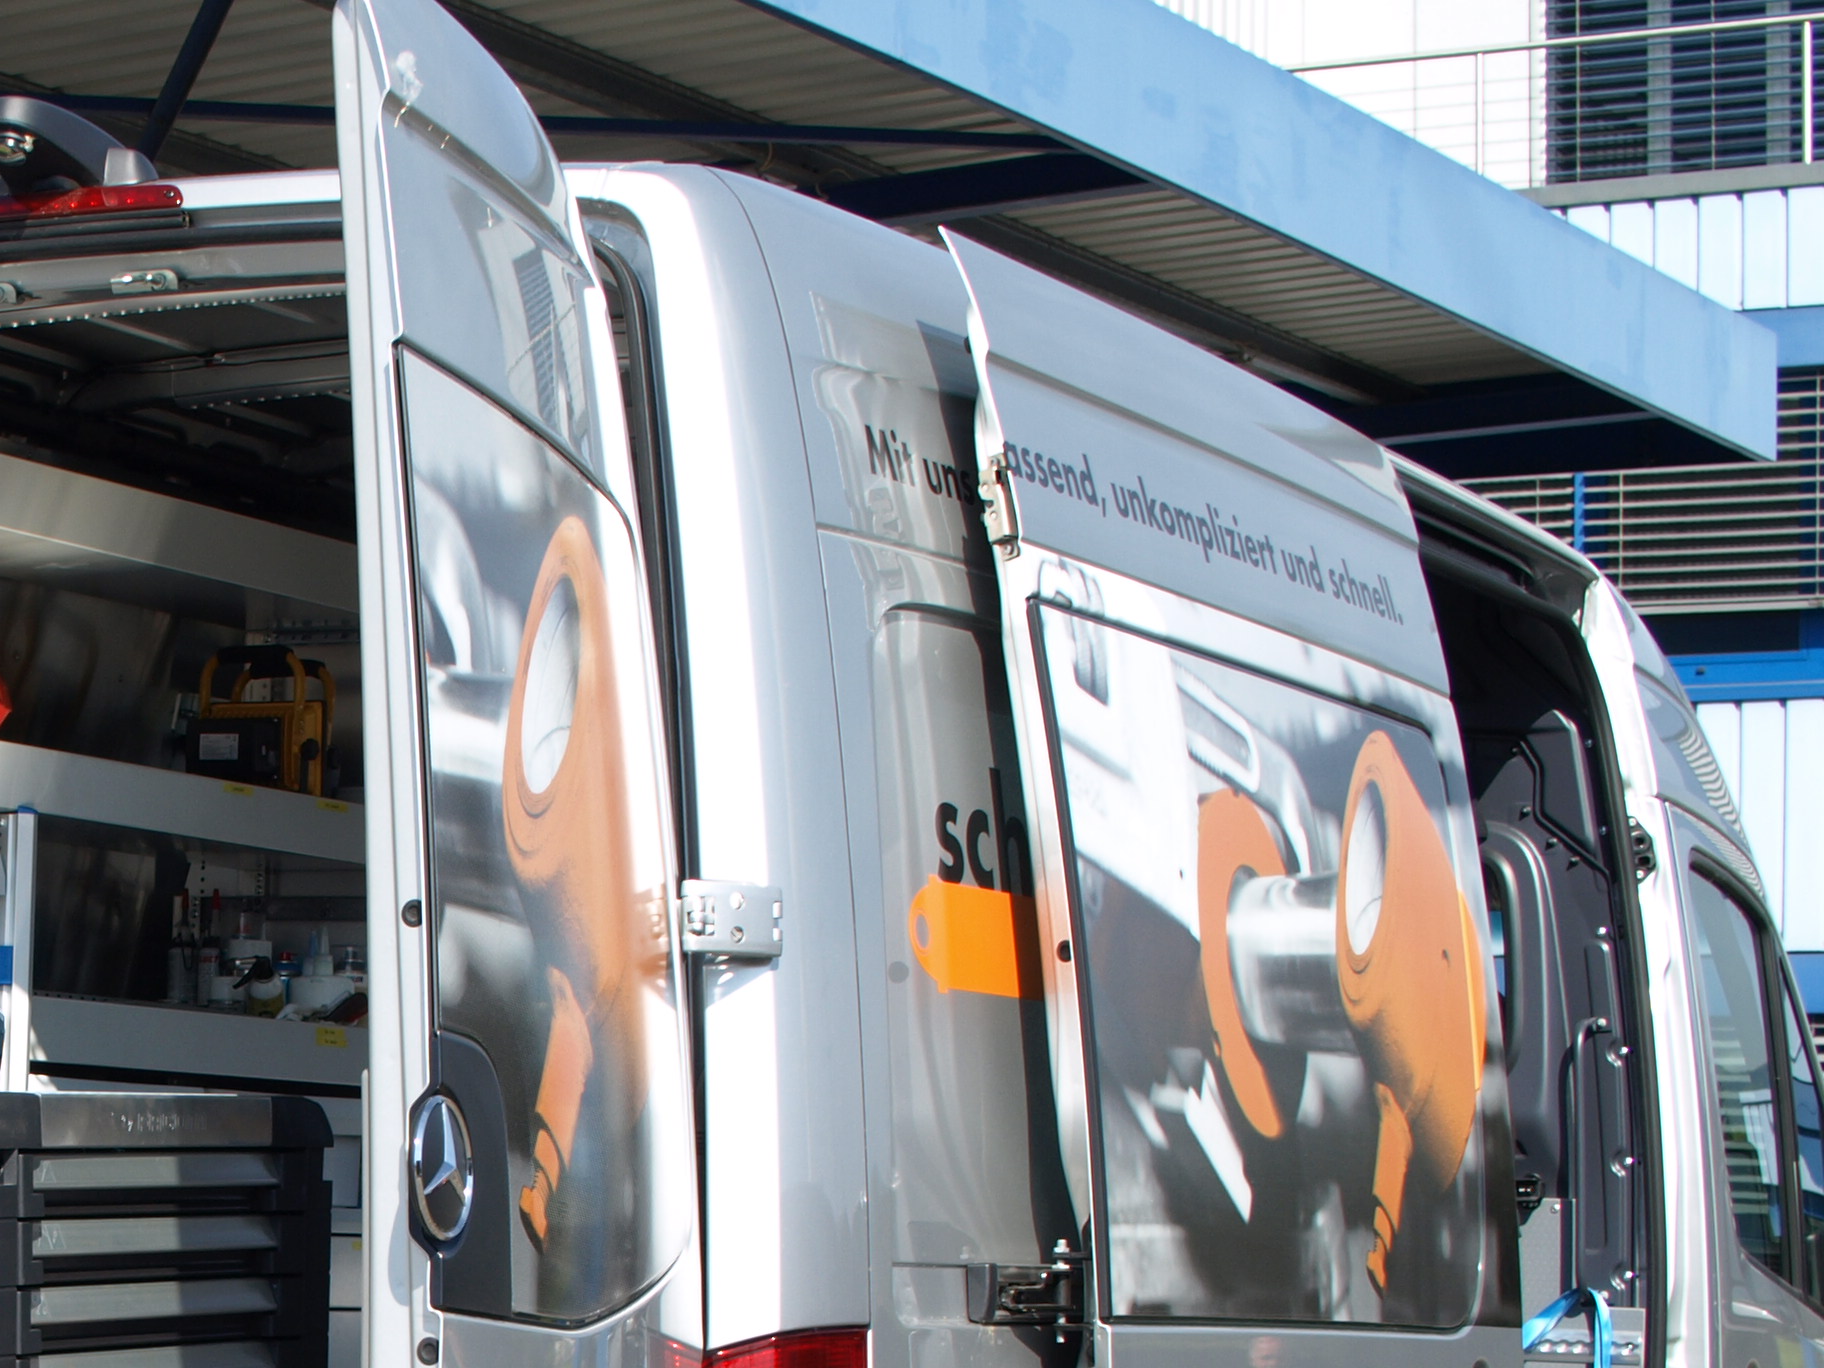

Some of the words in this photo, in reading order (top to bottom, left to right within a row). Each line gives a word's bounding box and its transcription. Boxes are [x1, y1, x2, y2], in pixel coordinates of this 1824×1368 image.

[863, 424, 916, 487] Mit
[1110, 475, 1278, 575] unkompliziert
[1280, 545, 1325, 594] und
[1329, 558, 1405, 626] schnell.
